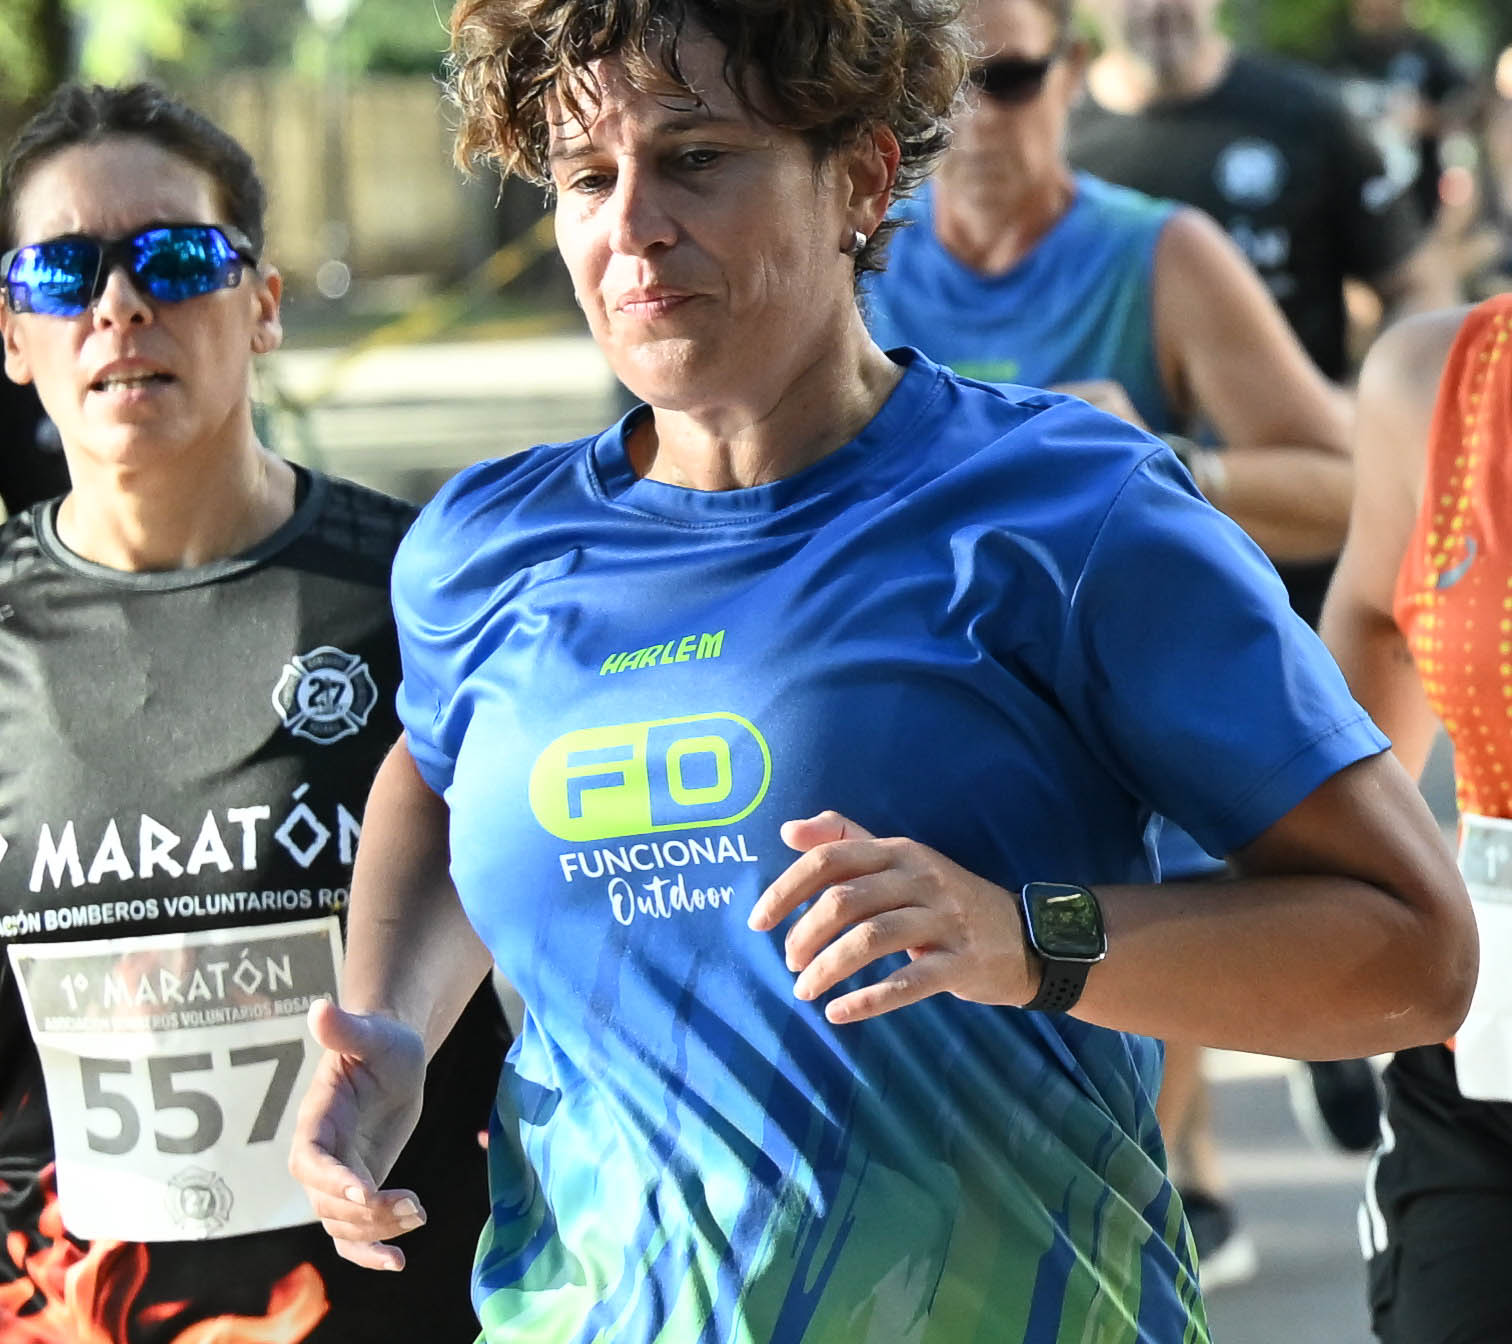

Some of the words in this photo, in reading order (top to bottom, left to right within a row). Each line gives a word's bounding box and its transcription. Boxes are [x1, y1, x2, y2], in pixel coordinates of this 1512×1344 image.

[600, 629, 725, 676] HARLEM
[308, 677, 345, 708] 27
[559, 834, 757, 882] FUNCIONAL
[44, 899, 159, 932] BOMBEROS
[163, 888, 313, 917] VOLUNTARIOS
[607, 875, 735, 926] Outdoor
[103, 948, 294, 1008] MARATÓN
[79, 1038, 305, 1155] 557
